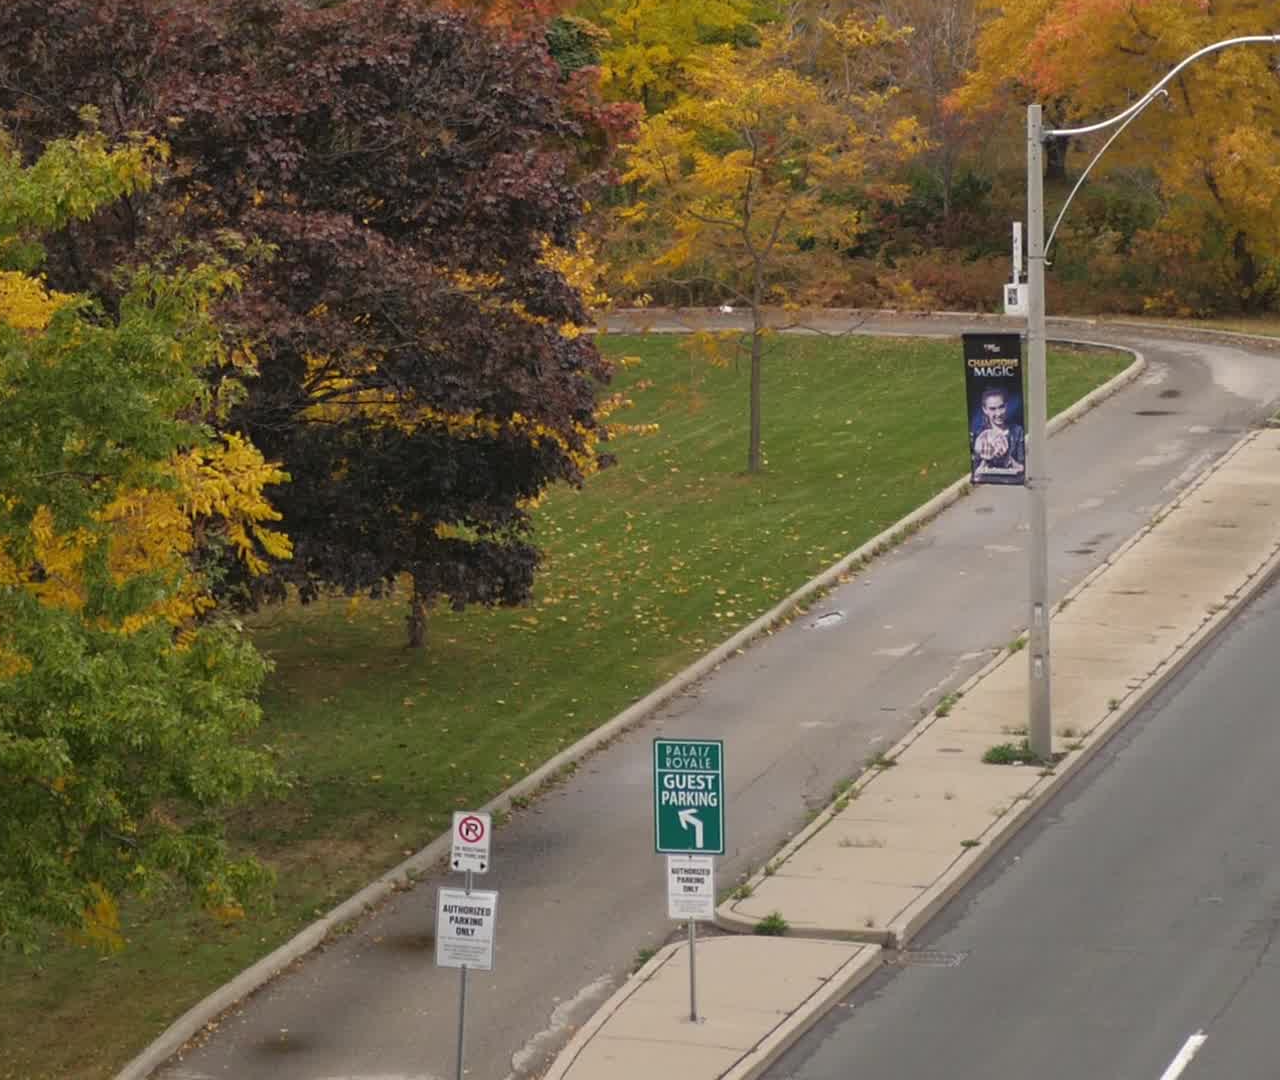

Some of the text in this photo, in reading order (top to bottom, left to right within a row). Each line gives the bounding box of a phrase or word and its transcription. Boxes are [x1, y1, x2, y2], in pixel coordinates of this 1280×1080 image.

[974, 366, 1015, 377] MAGIC
[665, 757, 712, 769] ROYALE
[663, 774, 716, 790] GUEST
[661, 790, 718, 807] PARKING
[442, 904, 492, 917] AUTHORIZED
[449, 915, 484, 927] PARKING
[455, 926, 476, 937] ONLY
